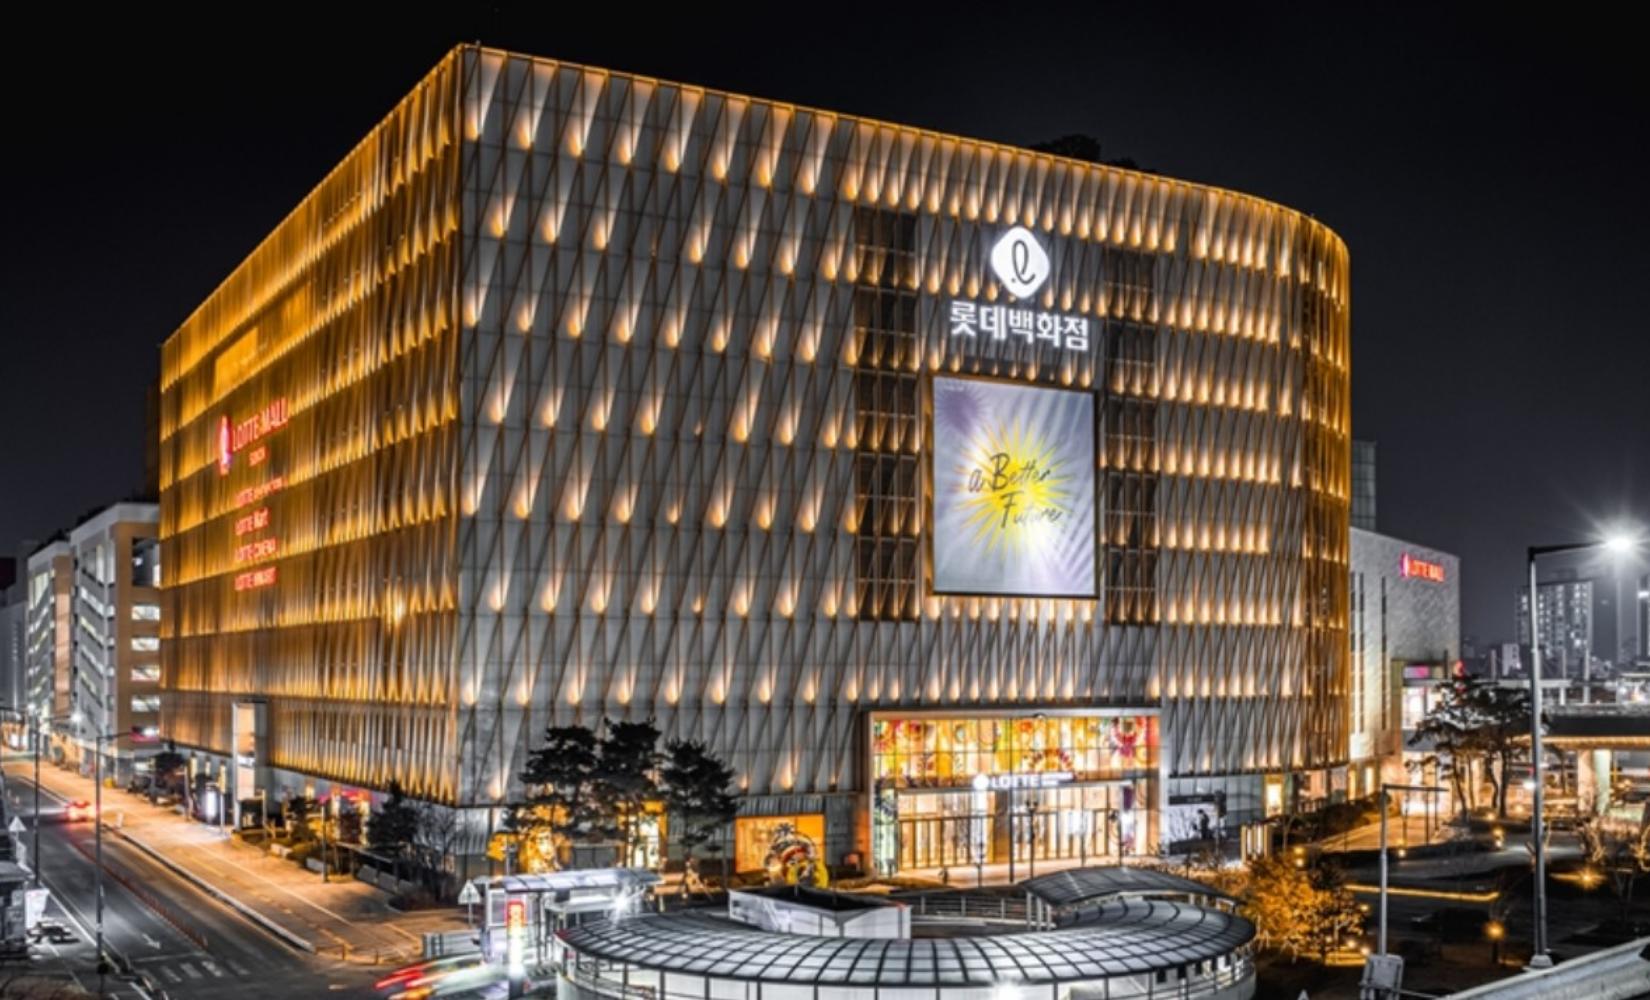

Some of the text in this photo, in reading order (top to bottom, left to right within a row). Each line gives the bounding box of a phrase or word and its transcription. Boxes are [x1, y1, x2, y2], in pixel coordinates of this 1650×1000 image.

[950, 301, 1088, 351] 롯데백화점
[232, 397, 289, 453] LOTTE MALL
[990, 453, 1051, 491] Better
[991, 774, 1040, 789] LOTTE
